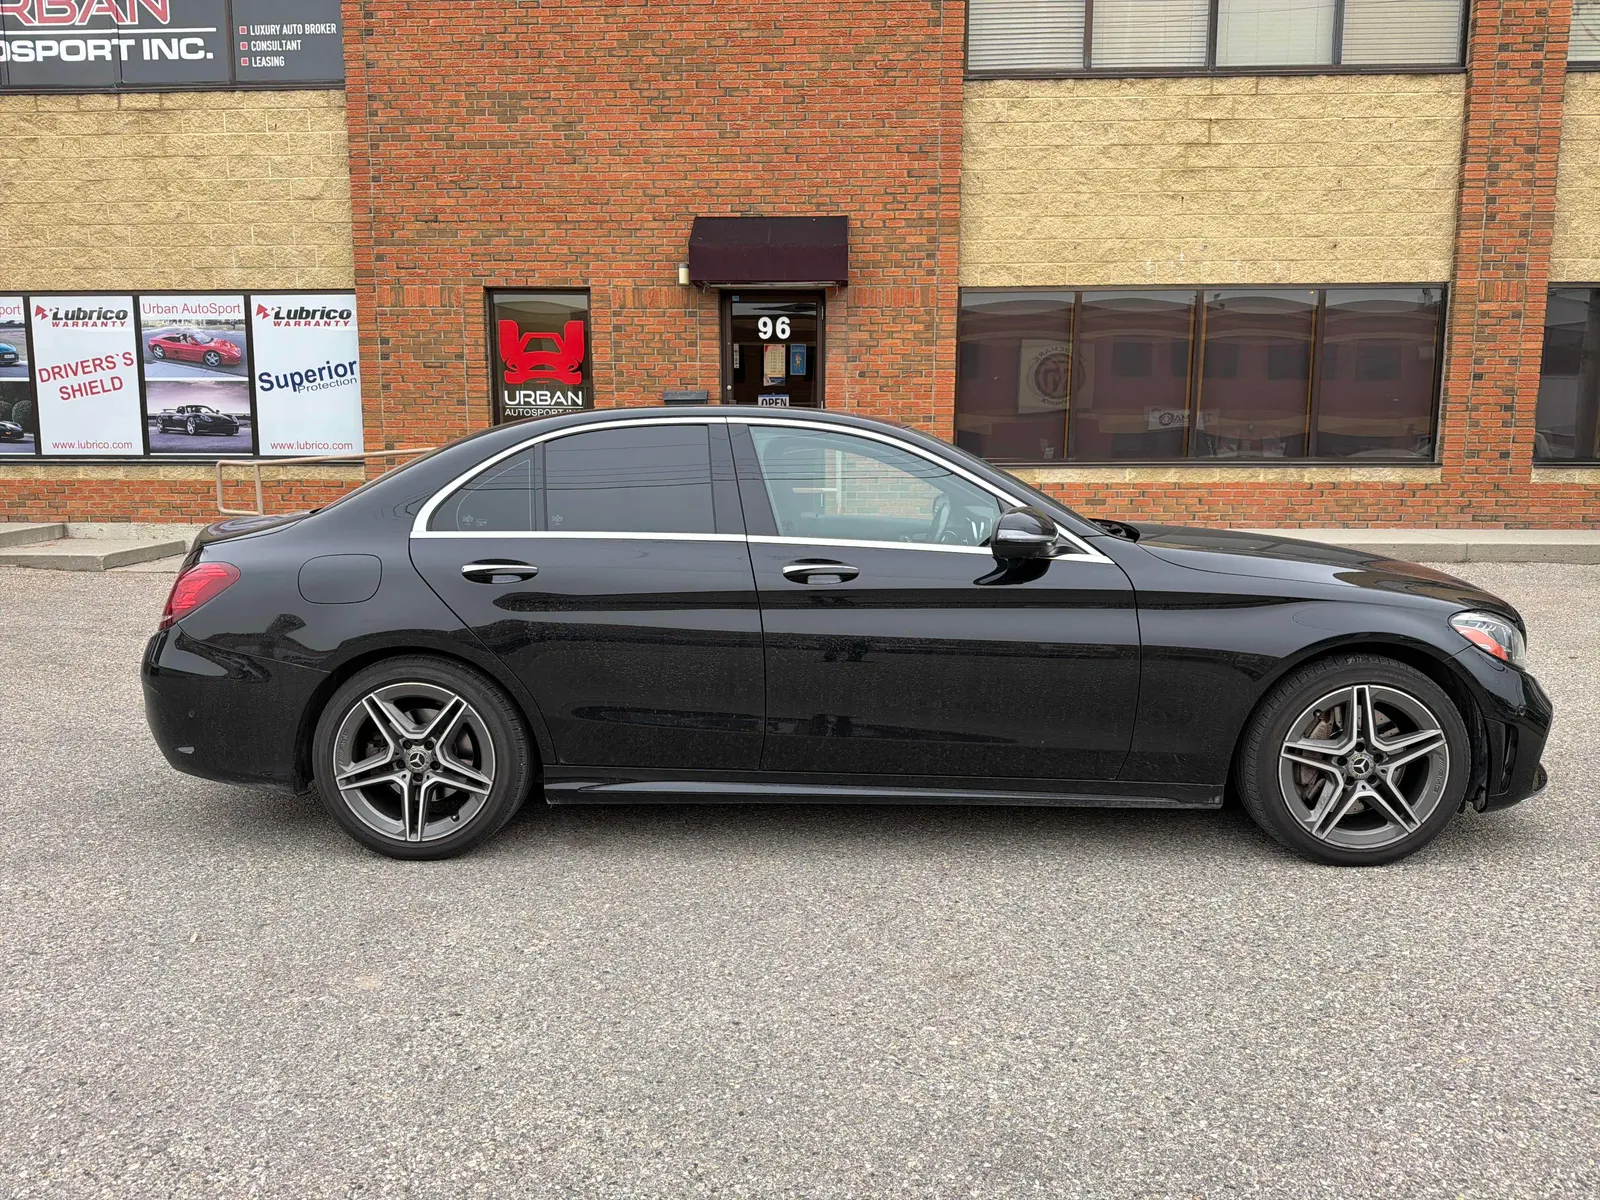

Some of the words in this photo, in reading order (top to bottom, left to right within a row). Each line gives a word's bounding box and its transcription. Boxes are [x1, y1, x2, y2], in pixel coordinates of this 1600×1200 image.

[250, 24, 280, 35] LUXURY
[282, 23, 303, 35] AUTO
[304, 23, 337, 34] BROKER
[142, 37, 214, 60] INC.
[250, 40, 302, 51] CONSULTANT
[251, 56, 285, 67] LEASING
[51, 307, 129, 321] Lubrico
[142, 303, 178, 315] Urban
[181, 302, 241, 316] AutoSport
[273, 306, 353, 320] Lubrico
[51, 320, 127, 328] WARRANTY
[757, 316, 791, 340] 96
[258, 360, 357, 392] Superior
[58, 375, 124, 401] SHIELD
[297, 377, 358, 394] Protection
[504, 390, 583, 406] URBAN
[52, 440, 133, 450] www.lubrico.com
[270, 441, 353, 450] www.lubrico.com
